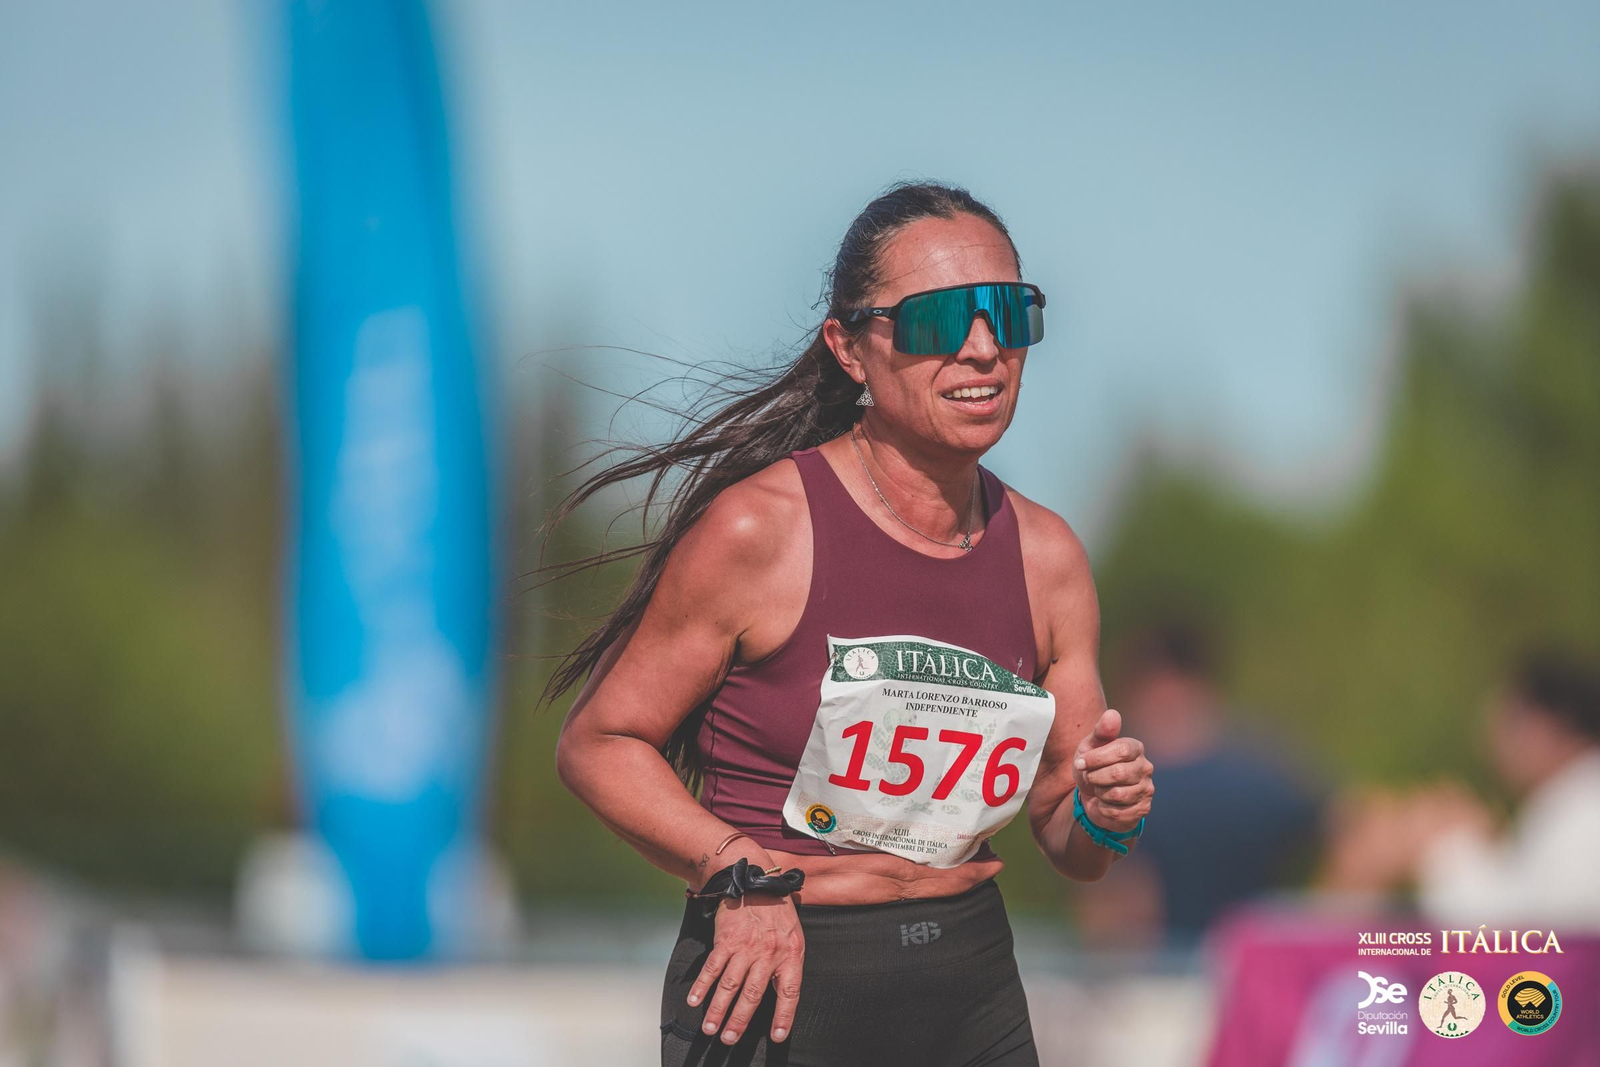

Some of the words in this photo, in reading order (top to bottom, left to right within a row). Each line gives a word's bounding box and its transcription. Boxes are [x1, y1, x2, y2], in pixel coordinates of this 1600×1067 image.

[896, 648, 998, 682] ITÁLICA
[970, 681, 999, 689] COUNTRY
[1014, 684, 1037, 694] Sevilla
[882, 688, 914, 699] MARTA
[915, 691, 960, 703] LORENZO
[962, 696, 1008, 710] BARROSO
[905, 702, 978, 718] INDEPENDIENTE
[828, 720, 1027, 807] 1576
[852, 829, 871, 838] CROSS
[872, 833, 916, 845] INTERNACIONAL
[883, 841, 916, 852] NOVIEMBRE
